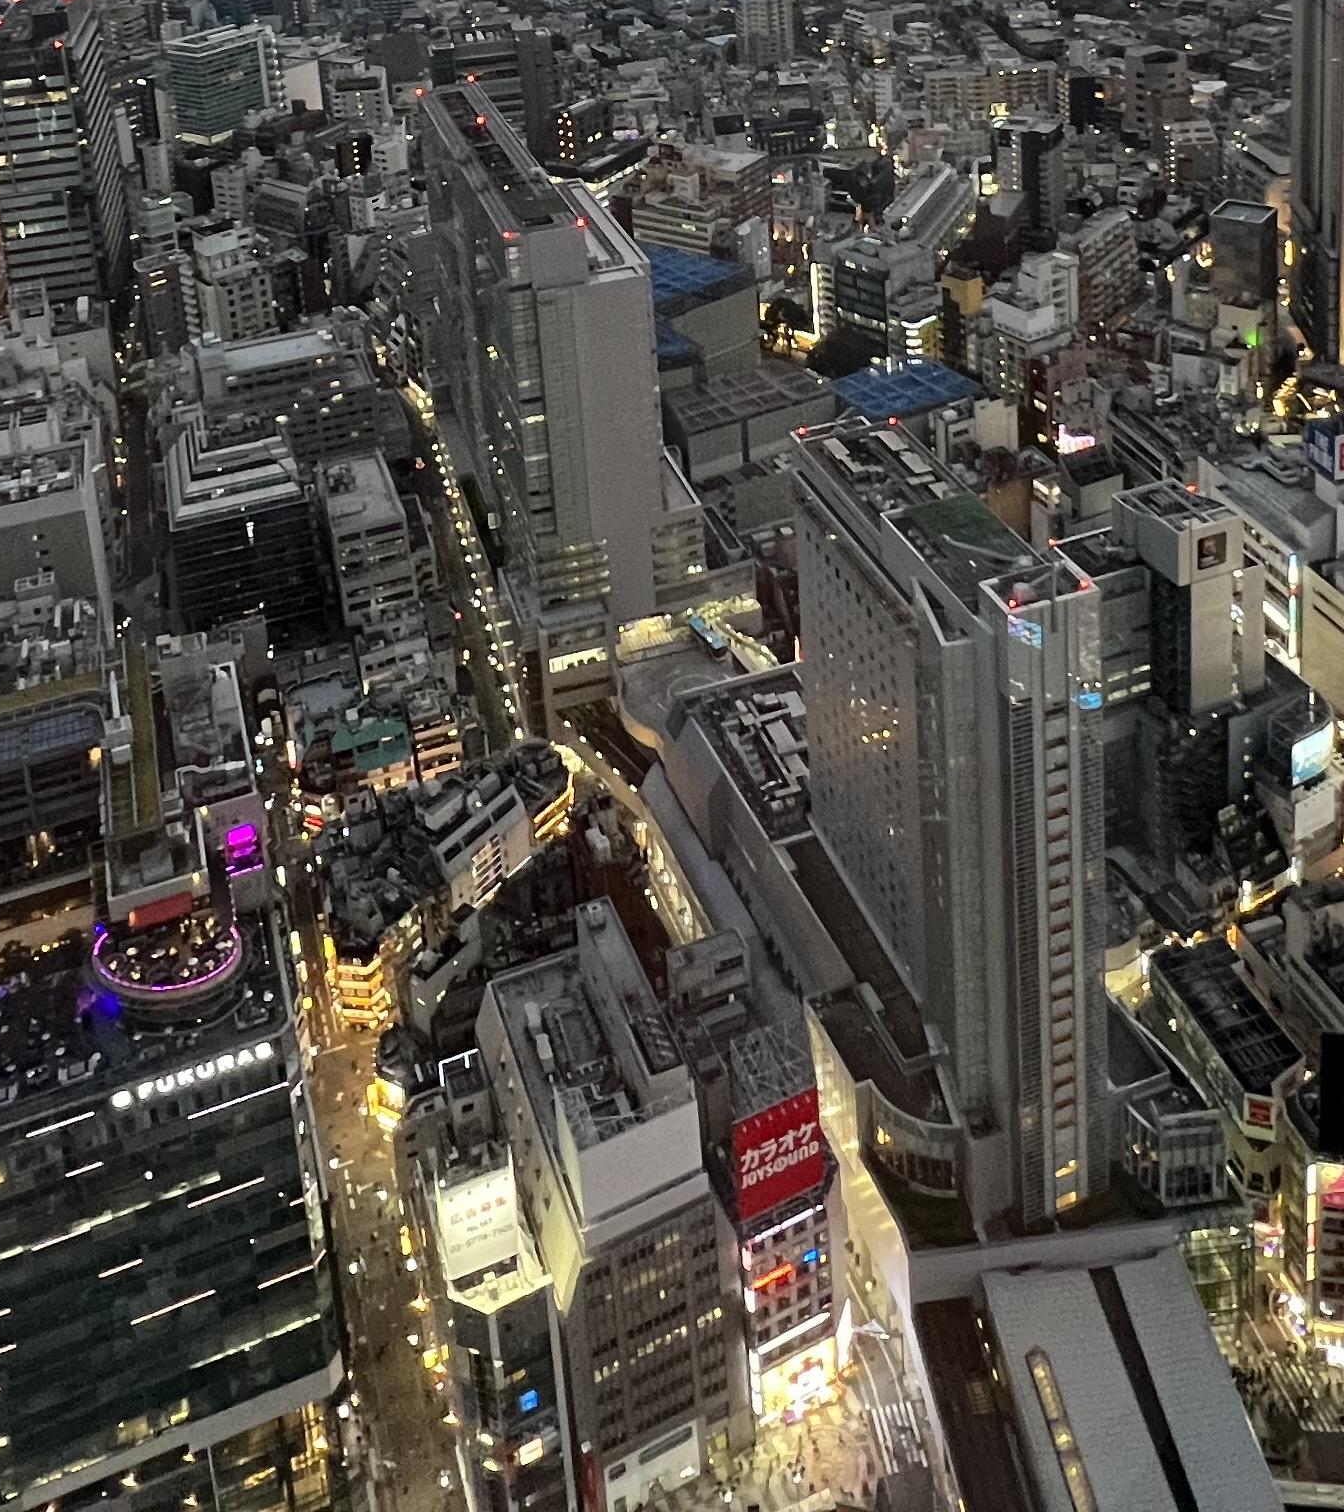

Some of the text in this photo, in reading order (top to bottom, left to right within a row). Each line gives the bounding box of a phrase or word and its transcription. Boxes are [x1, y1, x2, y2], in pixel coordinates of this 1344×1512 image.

[740, 1121, 817, 1173] カラオケ
[742, 1140, 820, 1189] JOYSOUND
